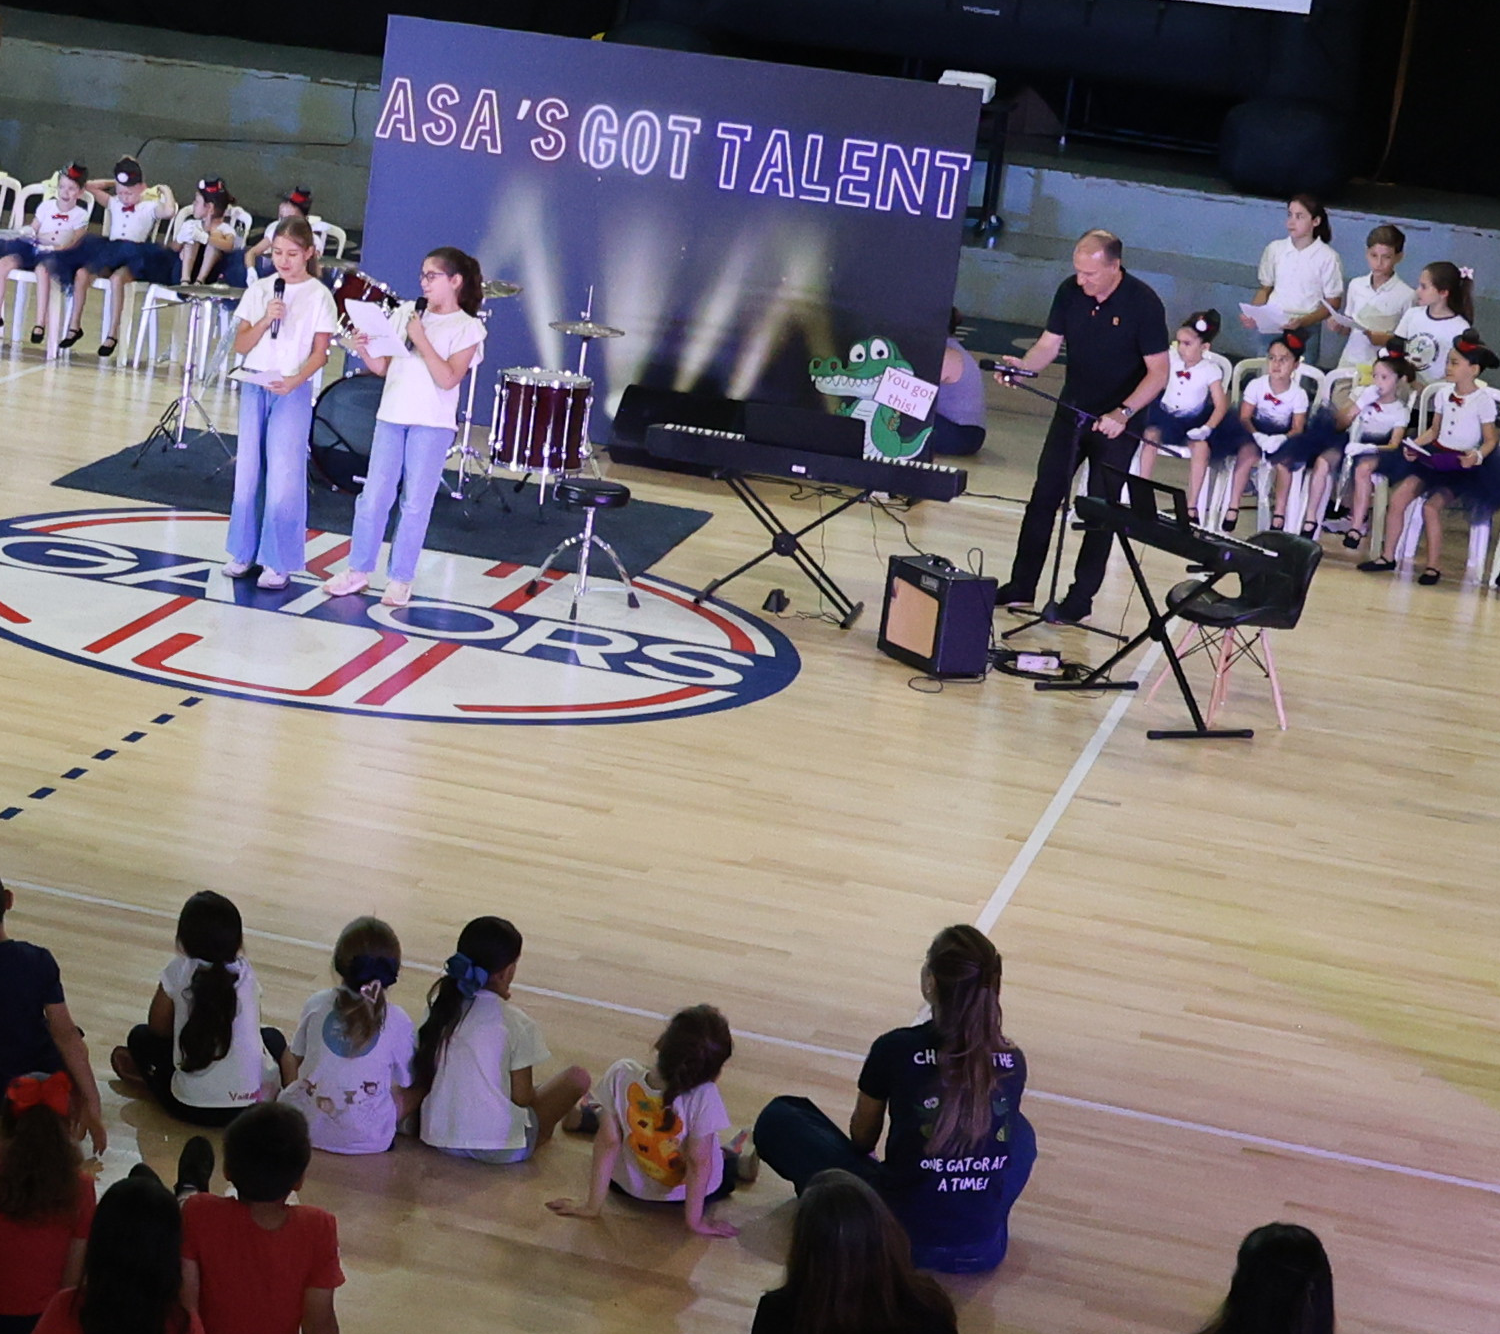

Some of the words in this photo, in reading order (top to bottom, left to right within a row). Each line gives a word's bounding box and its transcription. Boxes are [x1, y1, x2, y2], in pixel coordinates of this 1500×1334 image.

[375, 75, 569, 162] ASA'S
[579, 104, 702, 181] GOT
[716, 123, 973, 220] TALENT
[886, 371, 910, 391] You
[910, 385, 935, 401] got
[887, 393, 917, 414] this!
[920, 1158, 944, 1173] ONE
[946, 1156, 991, 1173] GATOR
[991, 1155, 1008, 1171] AT
[937, 1178, 948, 1192] A
[950, 1177, 990, 1193] TIME!
